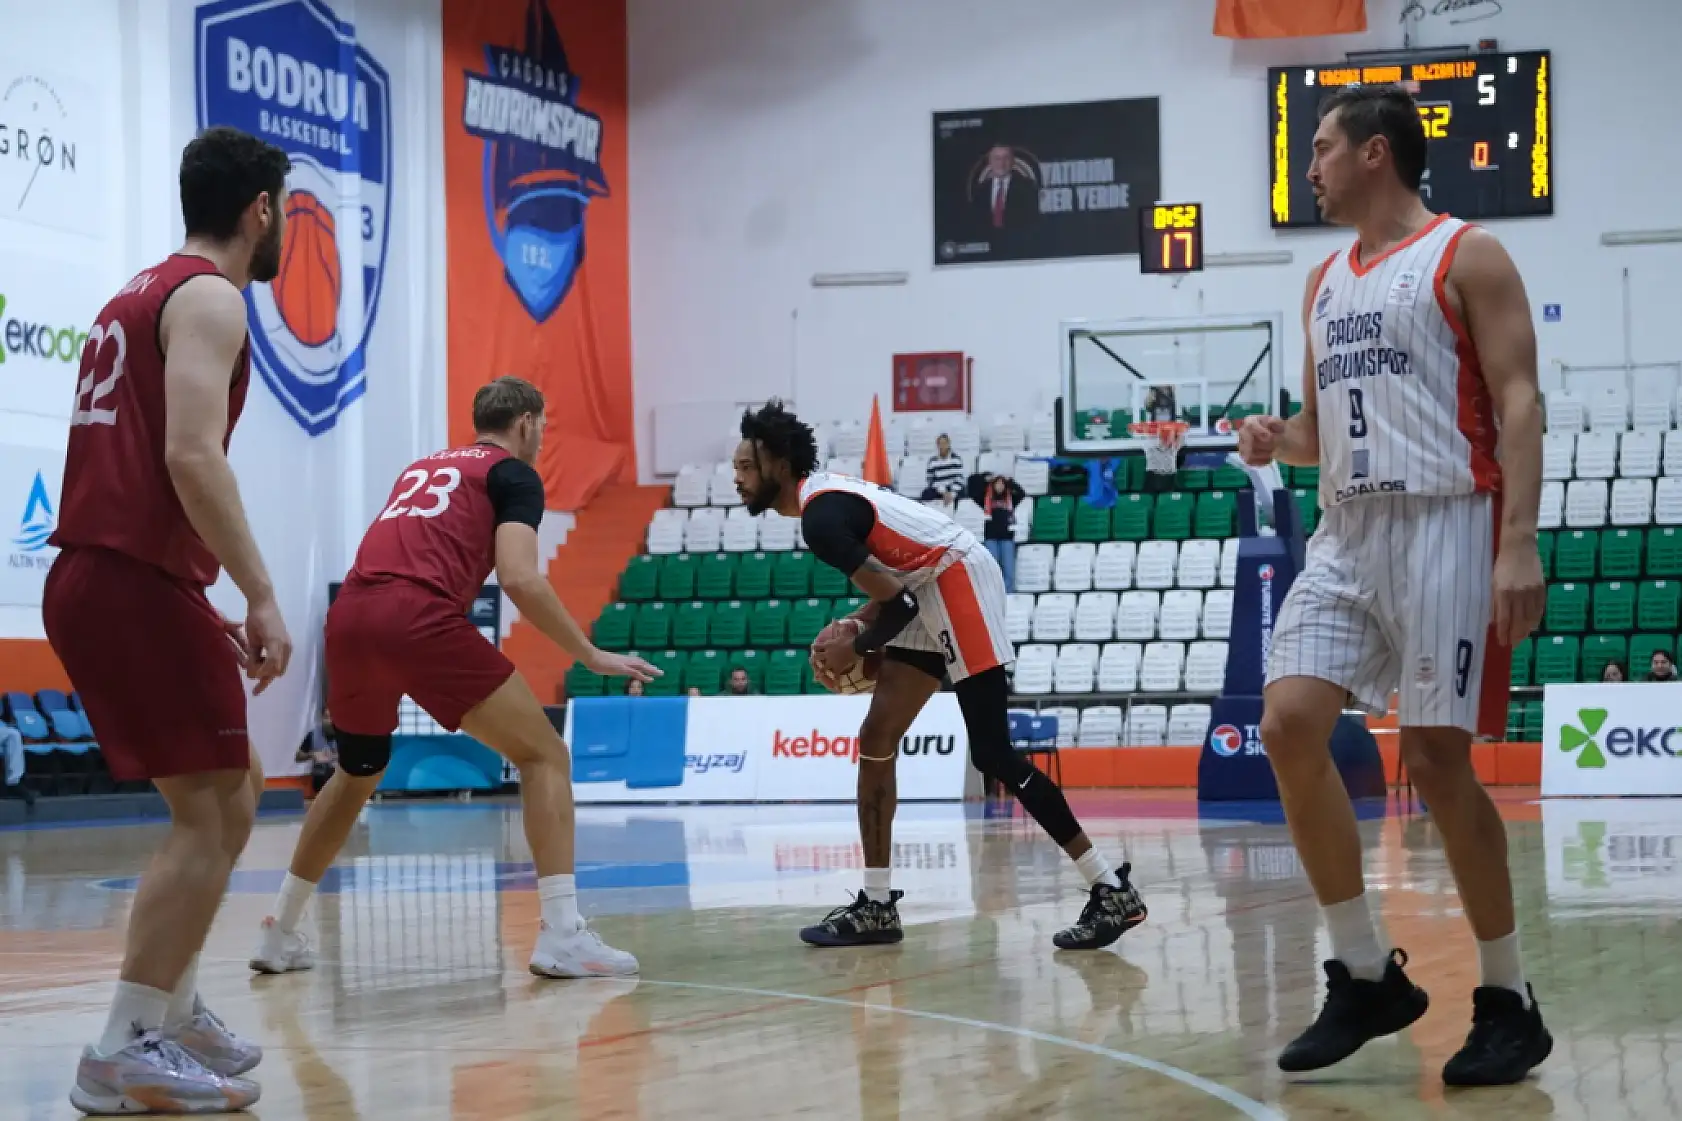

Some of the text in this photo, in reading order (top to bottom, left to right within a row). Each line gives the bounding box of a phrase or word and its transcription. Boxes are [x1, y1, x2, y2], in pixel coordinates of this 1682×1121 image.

[1477, 74, 1496, 105] 5
[1162, 231, 1193, 269] 17
[69, 319, 127, 426] 22
[1349, 388, 1368, 438] 9
[380, 466, 462, 520] 23
[1456, 638, 1473, 699] 9
